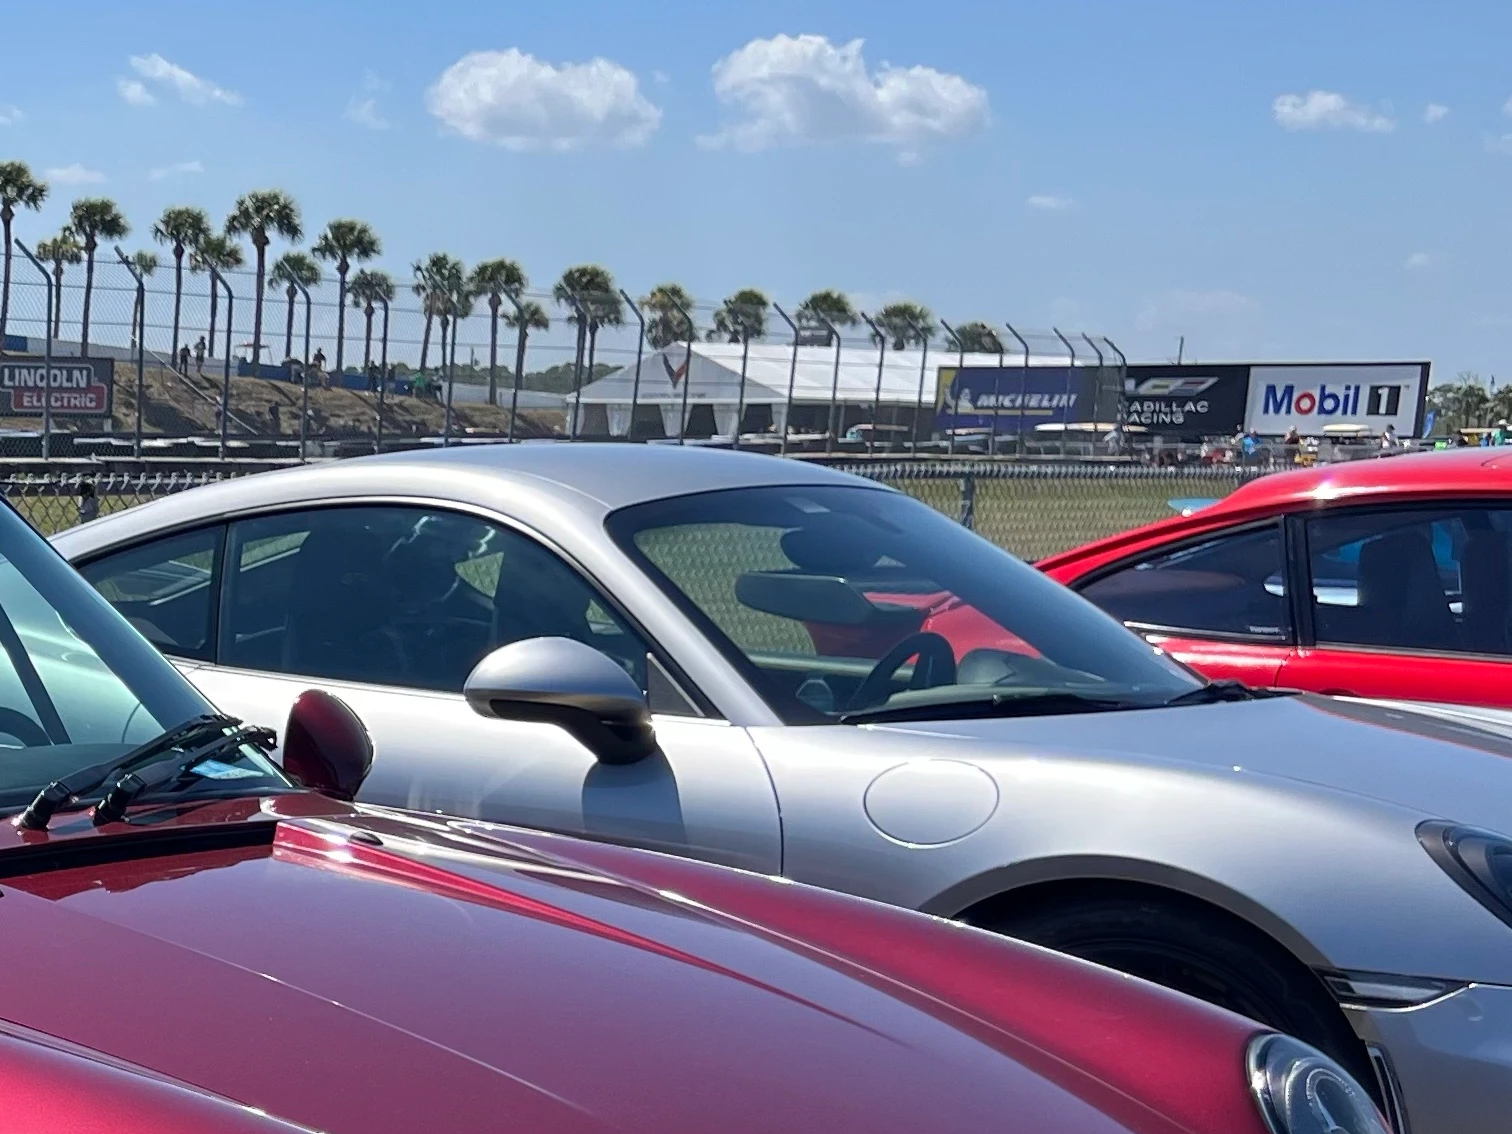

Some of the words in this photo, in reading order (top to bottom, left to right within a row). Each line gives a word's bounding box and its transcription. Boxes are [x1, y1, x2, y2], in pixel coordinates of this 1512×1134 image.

[3, 368, 88, 388] LINCOLN
[976, 393, 1078, 408] MICHELIN
[1123, 401, 1209, 413] ADILLAC
[1262, 384, 1360, 416] Mobil
[1122, 412, 1185, 424] ACING
